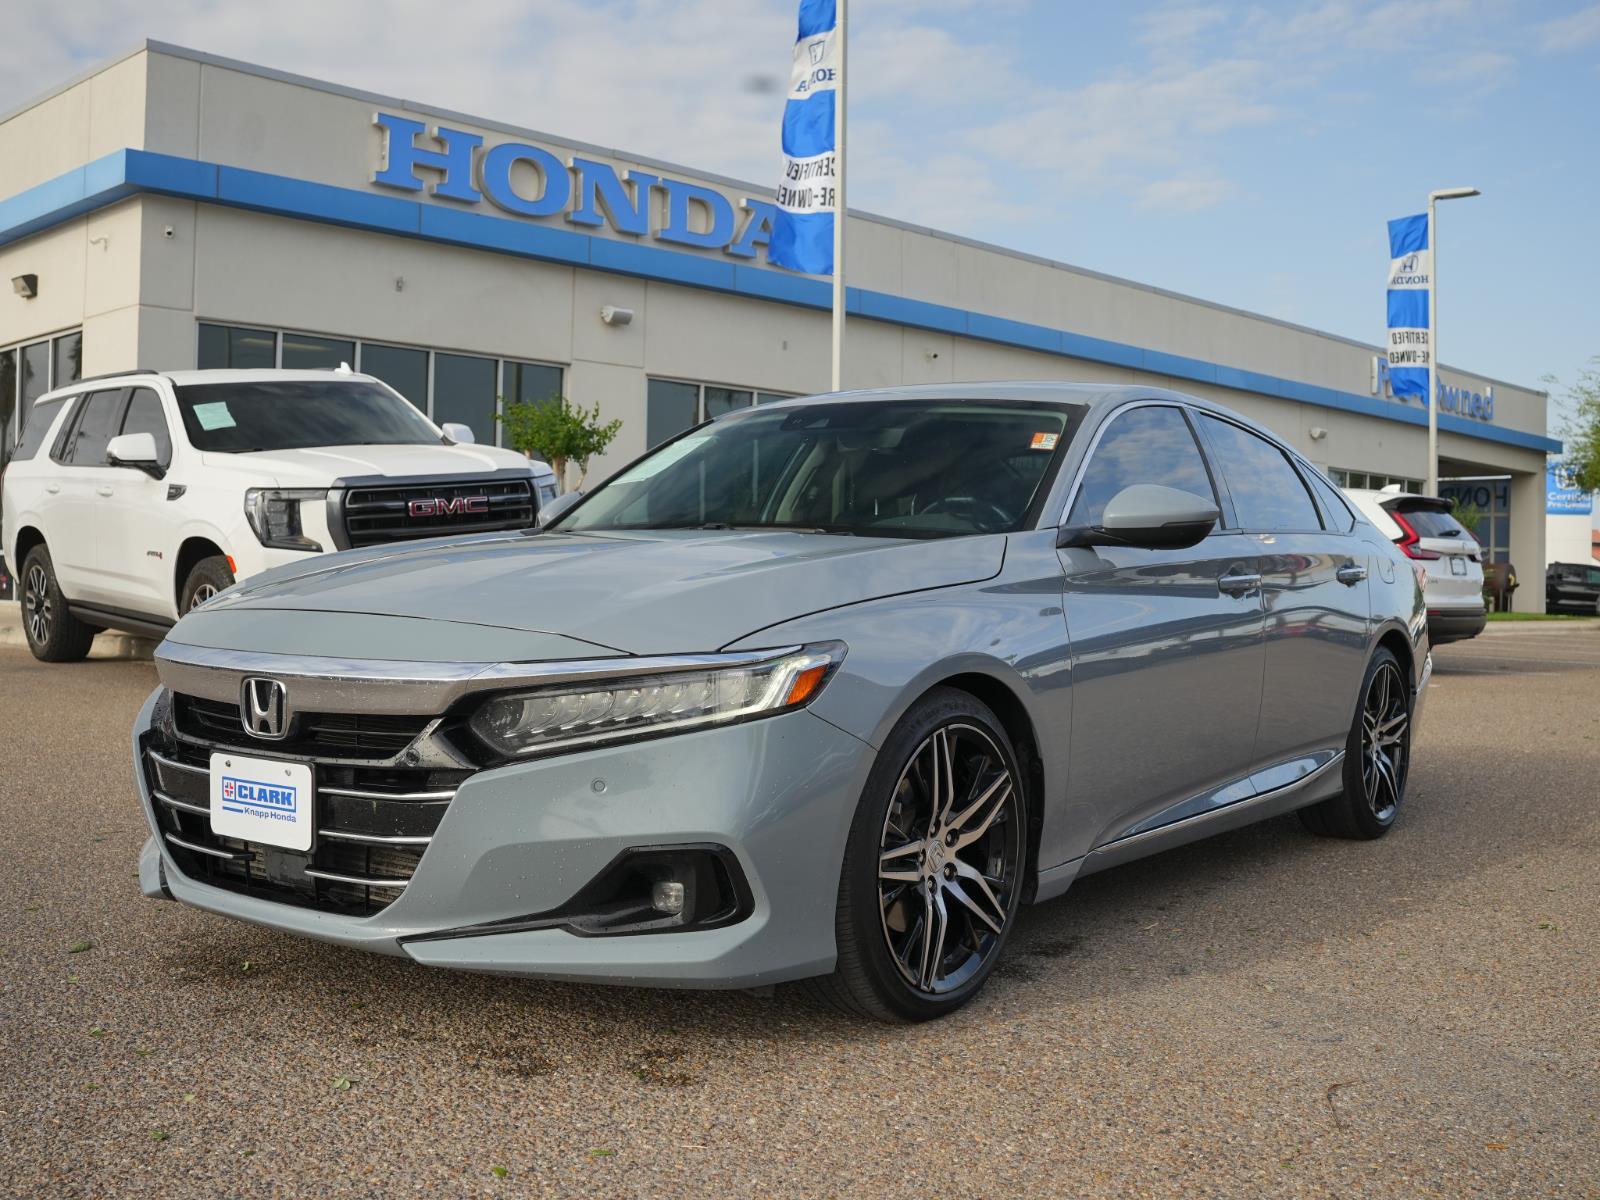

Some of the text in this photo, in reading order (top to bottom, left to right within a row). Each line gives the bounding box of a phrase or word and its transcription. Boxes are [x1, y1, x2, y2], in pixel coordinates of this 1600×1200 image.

[369, 112, 777, 260] HONDA
[408, 496, 488, 516] GMC
[237, 784, 293, 807] CLARK
[244, 806, 297, 823] Knapp Honda
